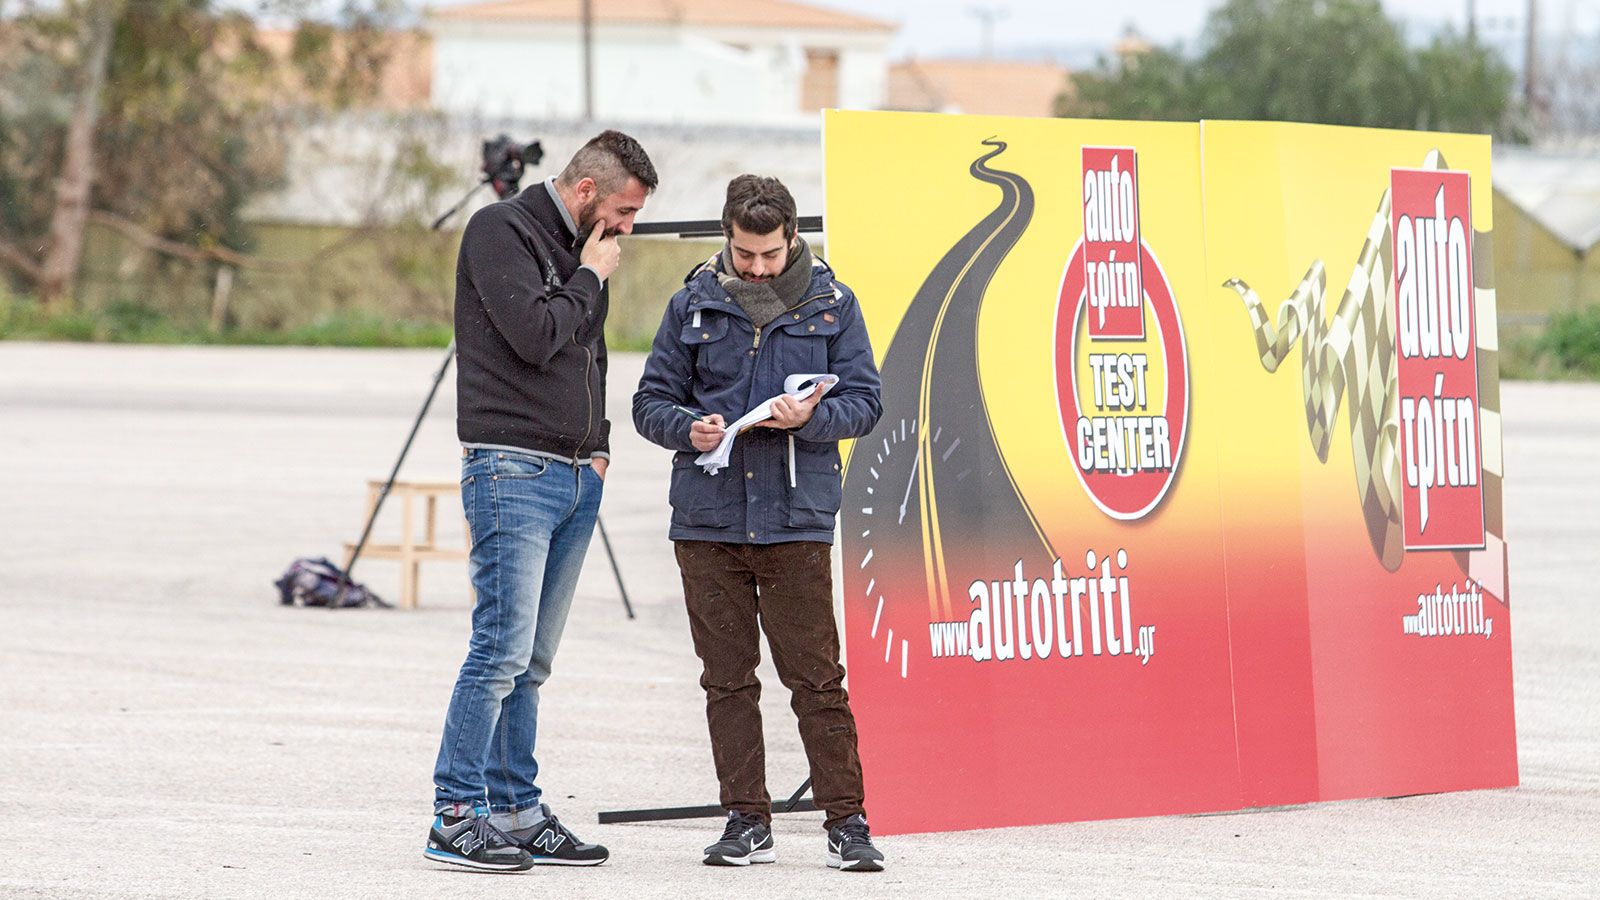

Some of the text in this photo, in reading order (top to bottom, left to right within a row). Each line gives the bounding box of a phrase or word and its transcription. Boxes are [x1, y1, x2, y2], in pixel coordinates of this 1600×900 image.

[1084, 153, 1135, 243] auto
[1396, 182, 1470, 360] auto
[1089, 353, 1147, 410] TEST
[1077, 415, 1172, 473] CENTER
[929, 548, 1156, 665] www.autotriti.gr
